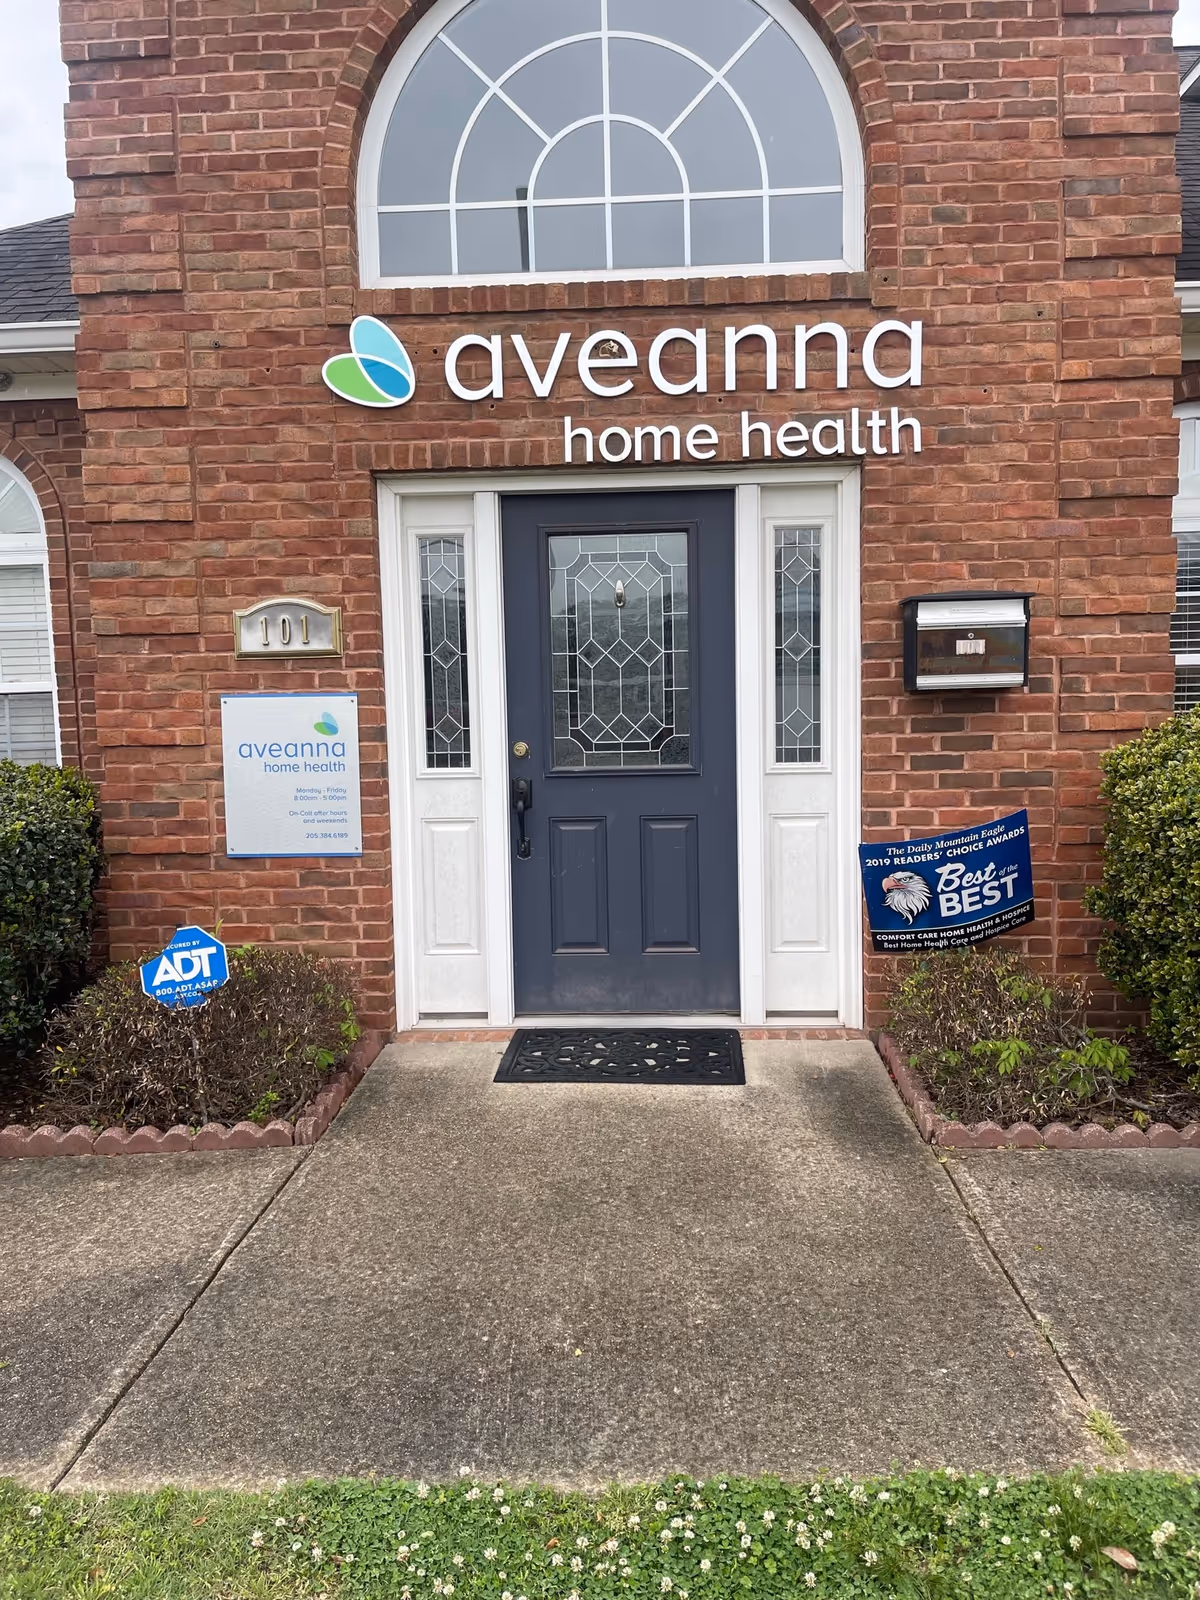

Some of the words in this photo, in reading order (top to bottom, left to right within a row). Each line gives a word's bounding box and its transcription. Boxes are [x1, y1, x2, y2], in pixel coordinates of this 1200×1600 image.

[444, 319, 922, 401] aveanna
[563, 415, 719, 463] home
[741, 406, 922, 459] health
[260, 615, 309, 646] 101
[238, 741, 346, 758] aveanna
[263, 761, 300, 773] home
[304, 760, 346, 772] health
[865, 858, 891, 867] 2019
[946, 841, 984, 857] CHOICE
[986, 825, 1025, 848] AWARDS
[886, 847, 905, 856] The
[907, 842, 933, 854] Daily
[935, 833, 979, 850] Mountain
[980, 824, 1006, 839] Eagle
[934, 861, 997, 893] Best
[998, 866, 1008, 876] of
[1007, 863, 1019, 873] the
[938, 872, 1019, 918] BEST
[876, 933, 917, 941] COMFORT
[917, 932, 938, 940] CARE
[939, 929, 965, 938] HOME
[966, 920, 994, 934] HEALTH
[1002, 904, 1031, 922] HOSPICE
[883, 941, 899, 949] Best
[900, 941, 923, 949] Home
[924, 938, 949, 949] Health
[950, 936, 969, 946] Care
[970, 932, 984, 941] and
[985, 923, 1010, 937] Hospice
[1011, 915, 1027, 926] Care
[166, 942, 190, 950] CURED
[152, 946, 217, 987] ADT
